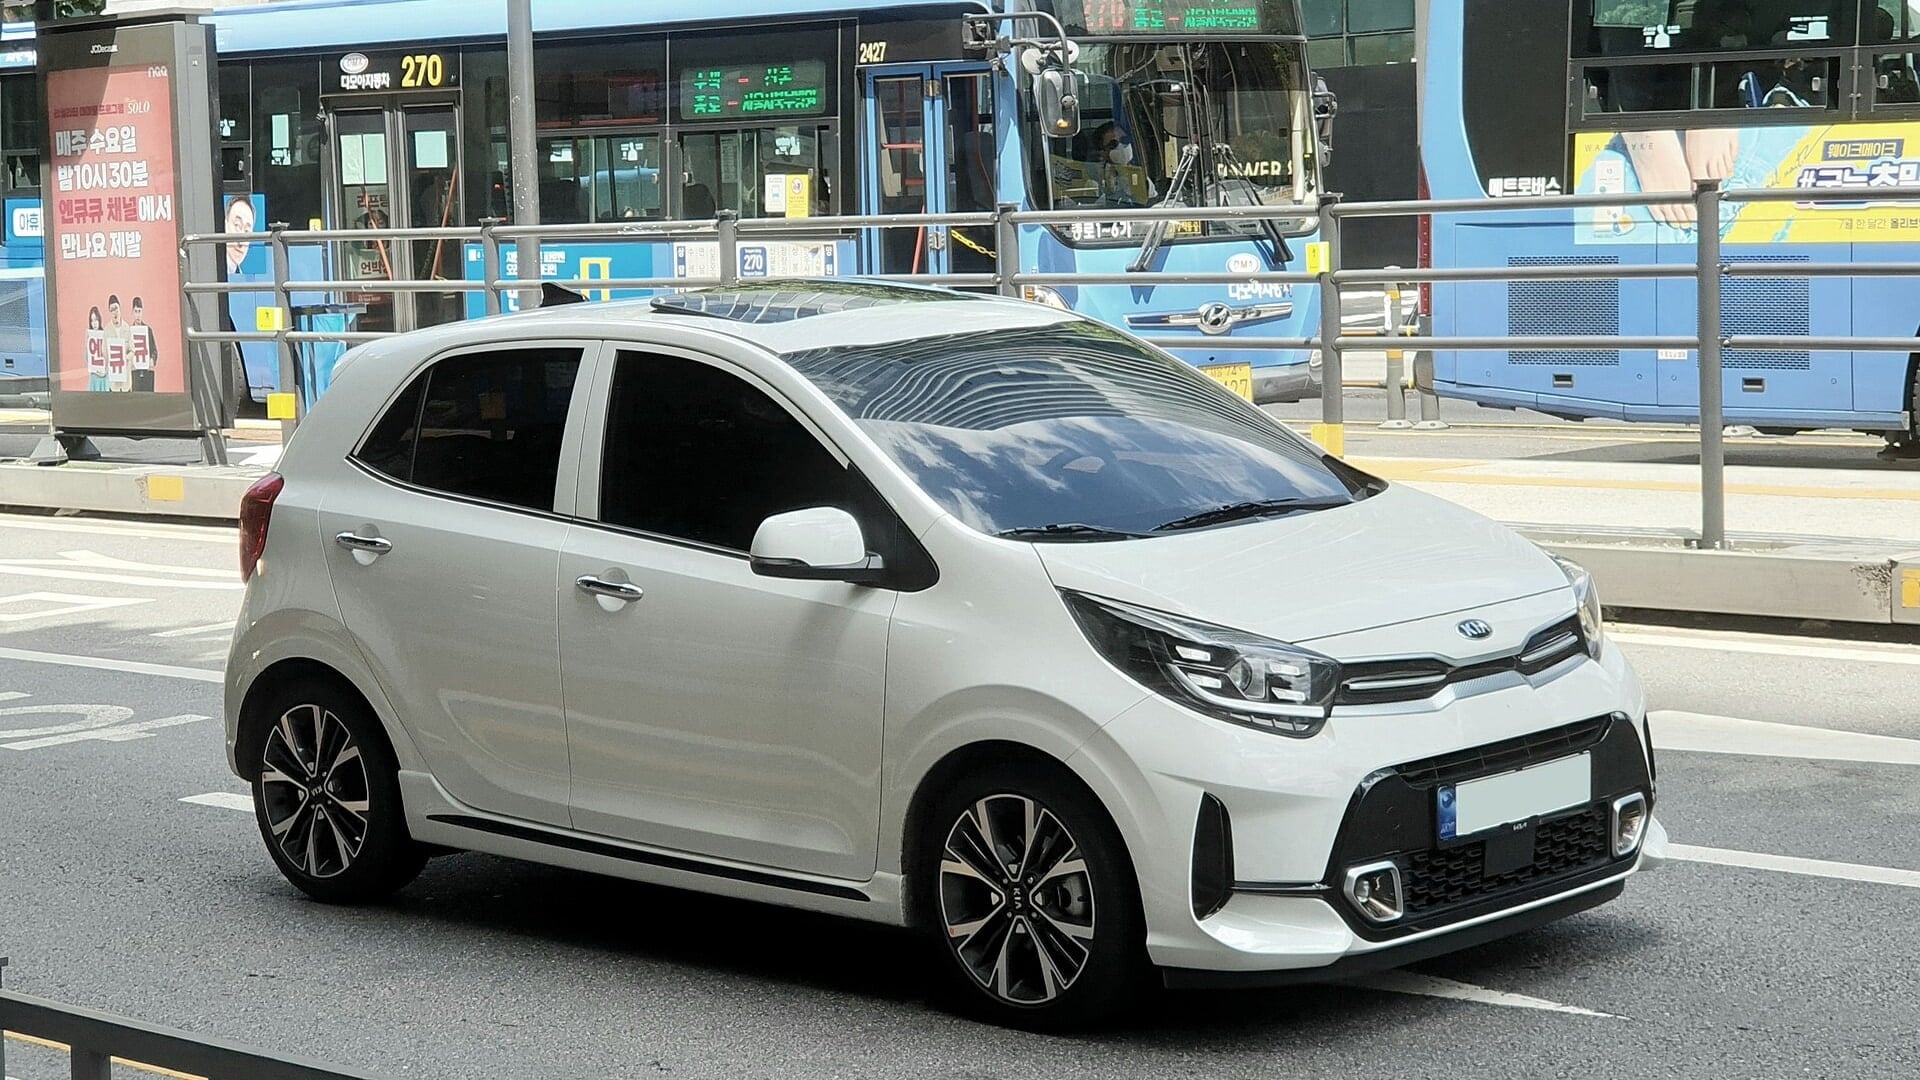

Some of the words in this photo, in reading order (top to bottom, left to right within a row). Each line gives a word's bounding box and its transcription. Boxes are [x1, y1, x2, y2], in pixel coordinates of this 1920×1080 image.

[860, 42, 887, 63] 2427
[401, 54, 443, 87] 270
[127, 100, 150, 114] SOLO
[55, 129, 87, 156] 매주
[89, 126, 137, 155] 수요일
[108, 159, 148, 189] 30분
[1488, 176, 1562, 198] 메트로버스
[58, 197, 103, 225] 엔큐큐
[1856, 218, 1866, 230] 한
[1890, 217, 1920, 230] 올리브
[1071, 221, 1133, 241] 종로1~6가
[61, 230, 107, 260] 만나요
[109, 230, 142, 258] 제발
[743, 254, 763, 270] 270
[88, 337, 104, 367] 엔
[109, 344, 125, 375] 큐
[133, 333, 148, 364] 큐
[1460, 621, 1490, 636] KIA
[1013, 887, 1023, 910] KIA
